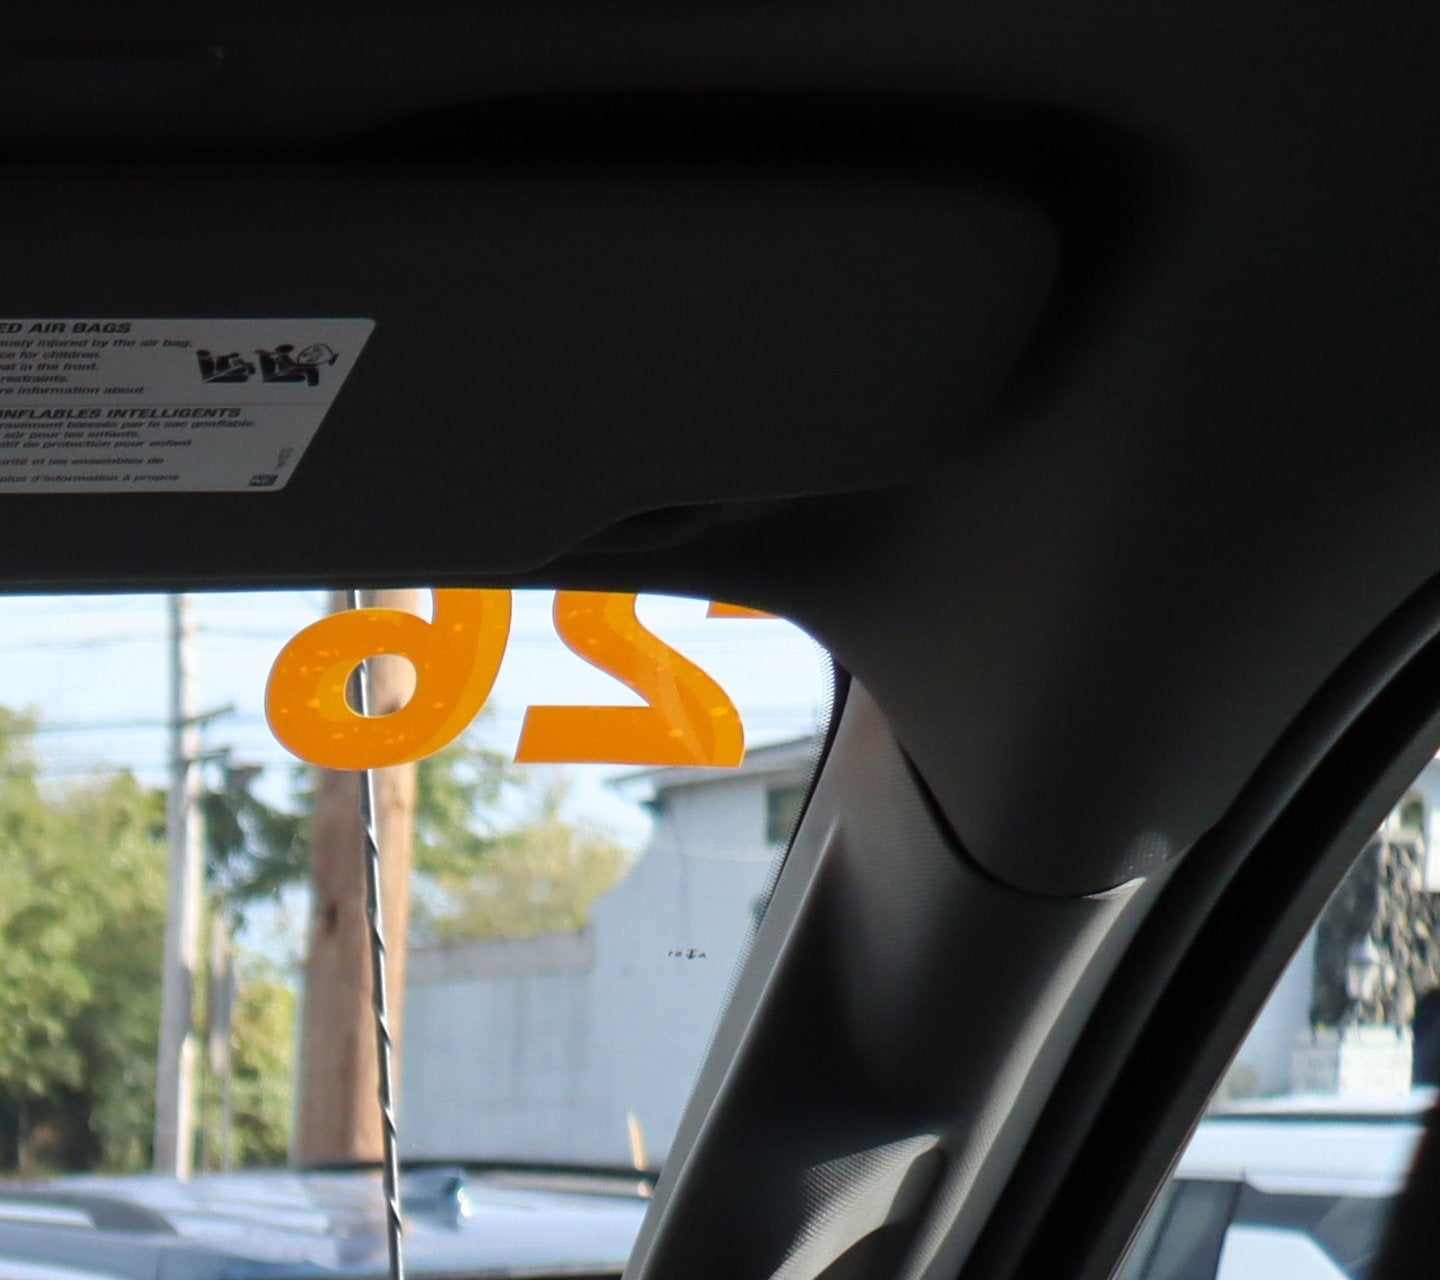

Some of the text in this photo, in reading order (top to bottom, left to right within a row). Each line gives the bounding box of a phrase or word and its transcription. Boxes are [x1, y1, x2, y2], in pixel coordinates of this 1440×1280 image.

[28, 322, 67, 334] AIR
[71, 322, 131, 334] BAGS
[107, 407, 242, 419] INTELLIGENTS
